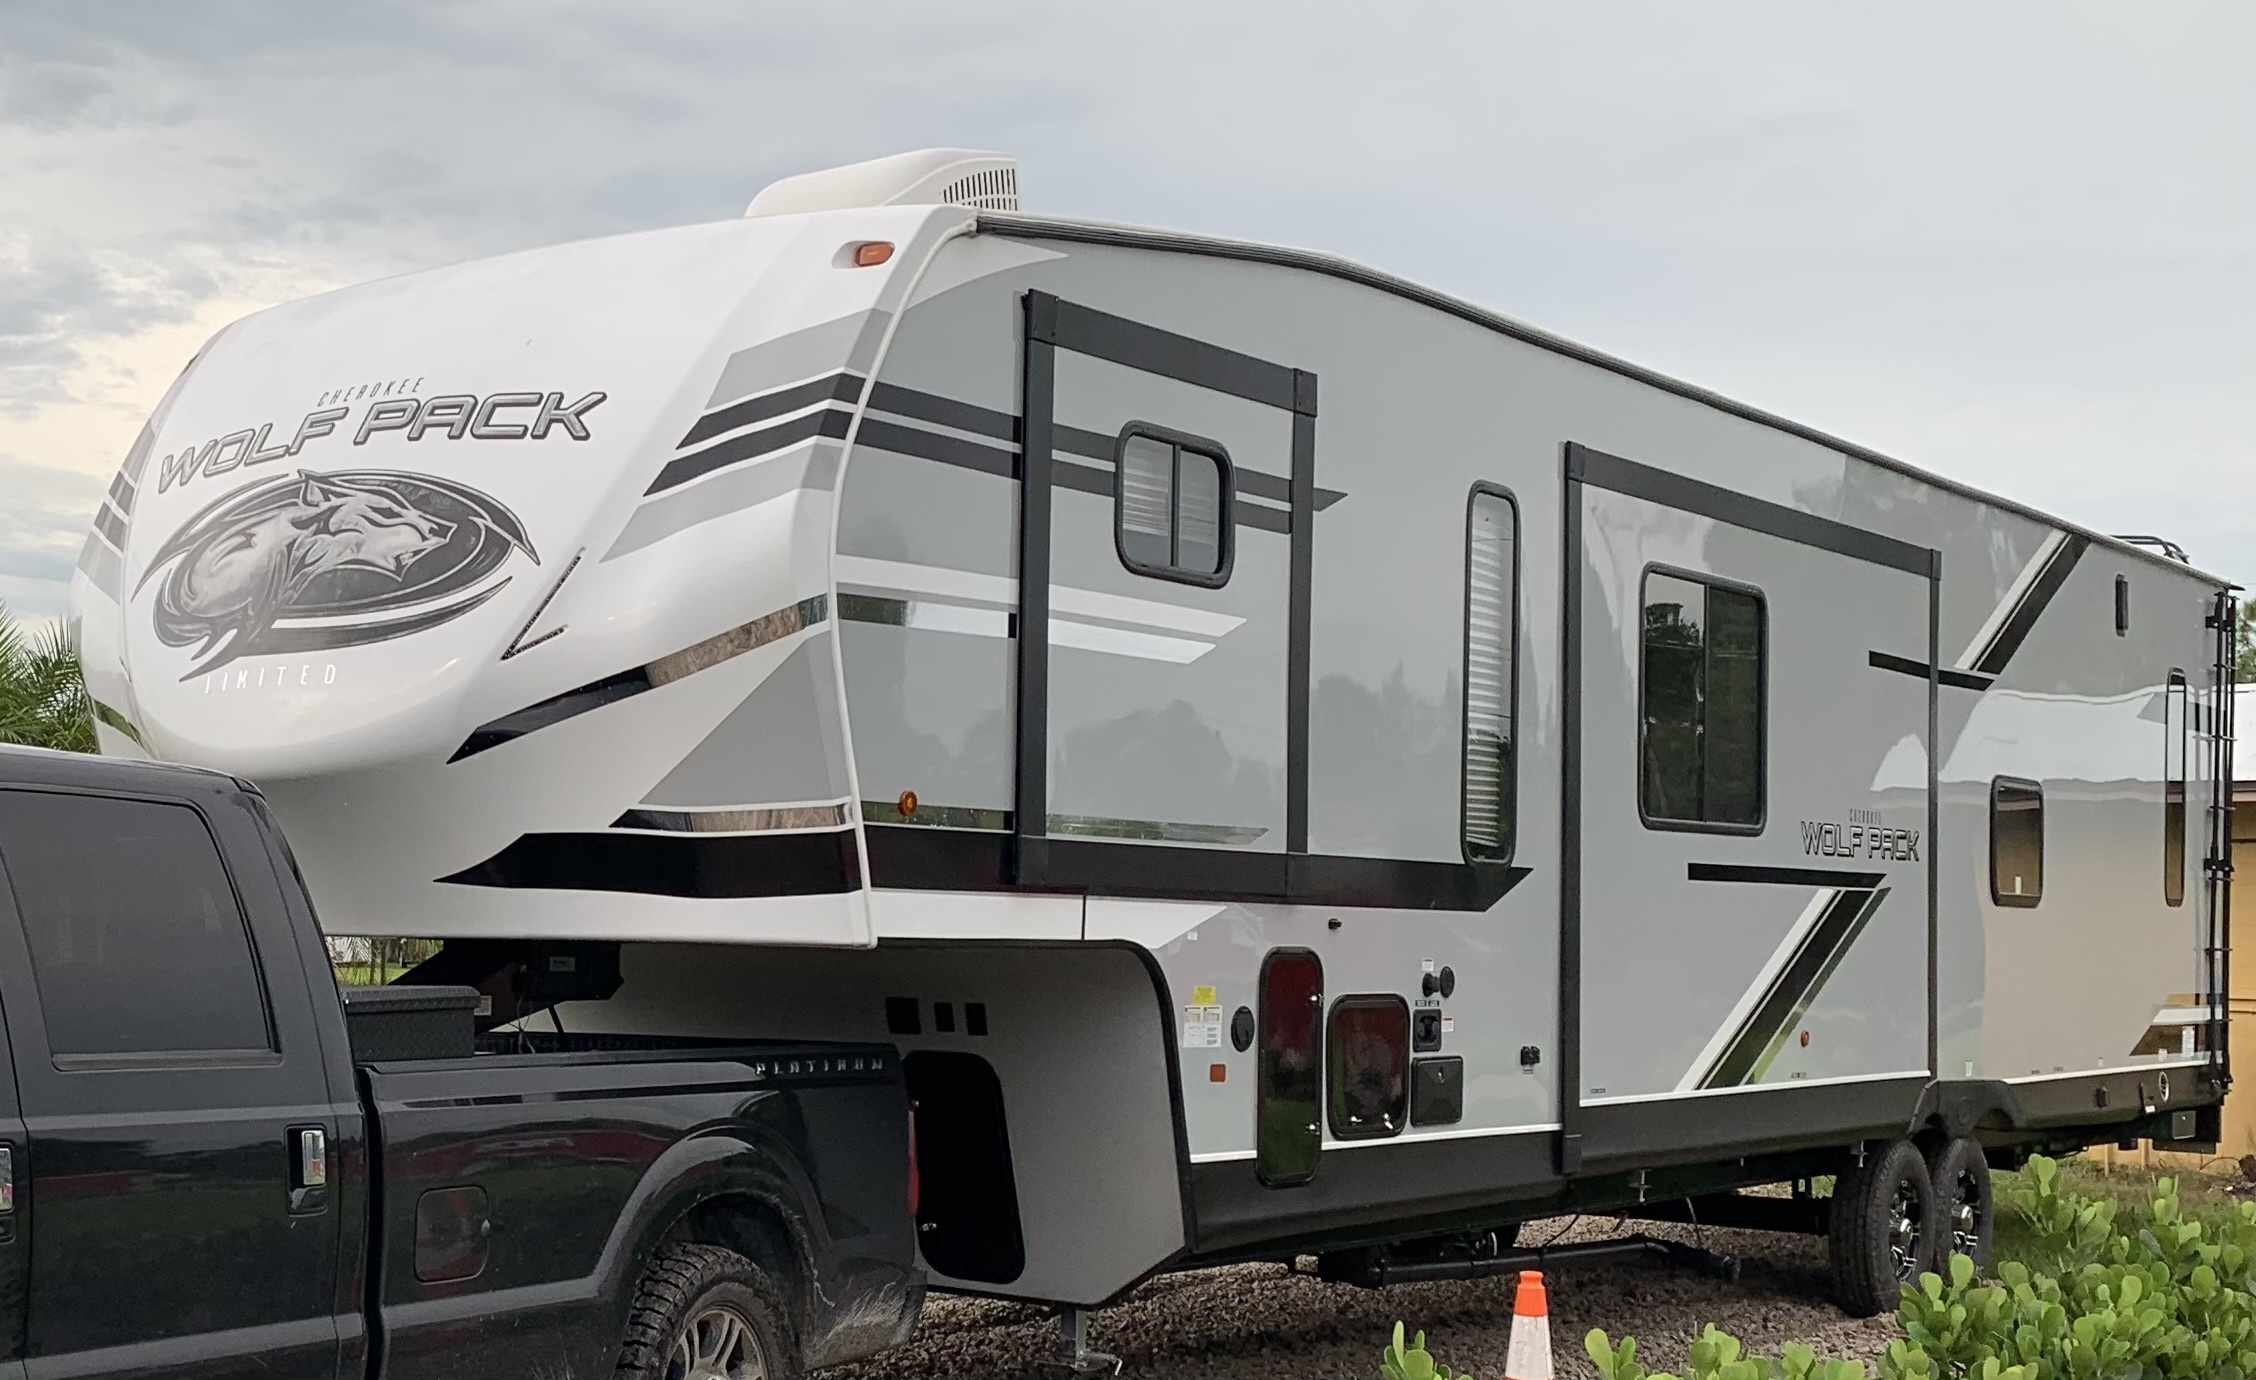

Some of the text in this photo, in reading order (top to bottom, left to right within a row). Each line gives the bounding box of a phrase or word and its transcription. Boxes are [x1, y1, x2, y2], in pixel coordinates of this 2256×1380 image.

[317, 376, 425, 407] CHEROKEE
[157, 392, 607, 494] WOLF PACK
[204, 664, 337, 694] LIMITED
[1800, 820, 1920, 862] WOLF PACK
[755, 1058, 883, 1075] PLATINUM
